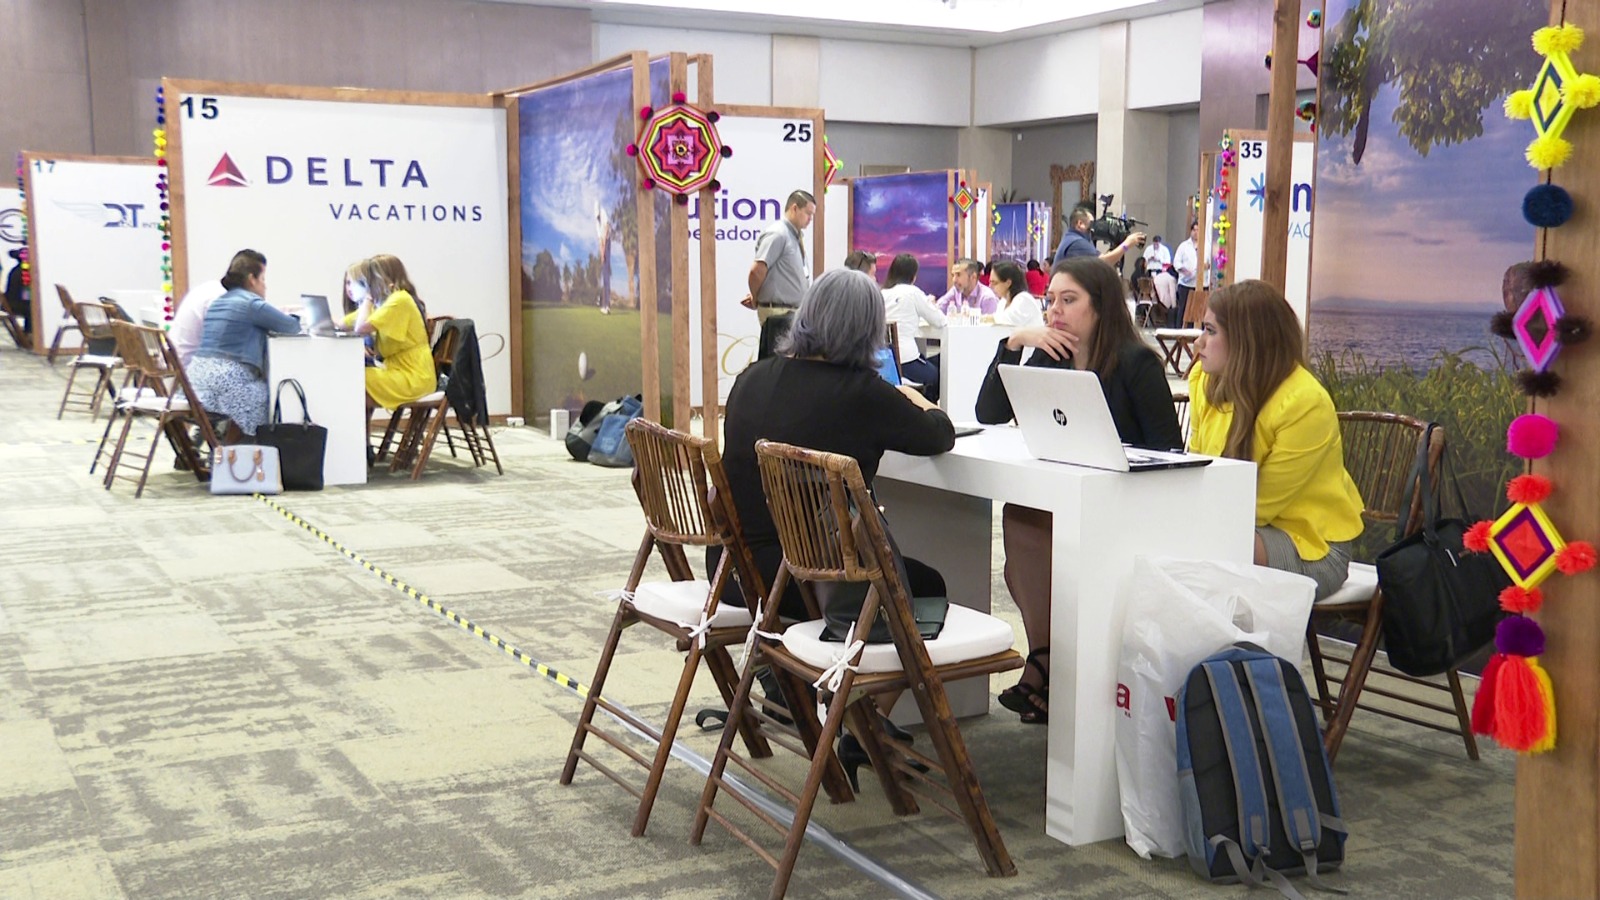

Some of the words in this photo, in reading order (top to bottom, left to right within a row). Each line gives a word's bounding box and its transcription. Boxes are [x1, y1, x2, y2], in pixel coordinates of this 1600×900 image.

[179, 97, 219, 120] 15
[783, 123, 812, 142] 25
[1241, 142, 1263, 159] 35
[266, 156, 429, 188] DELTA
[329, 203, 483, 222] VACATIONS
[1053, 408, 1068, 426] hp
